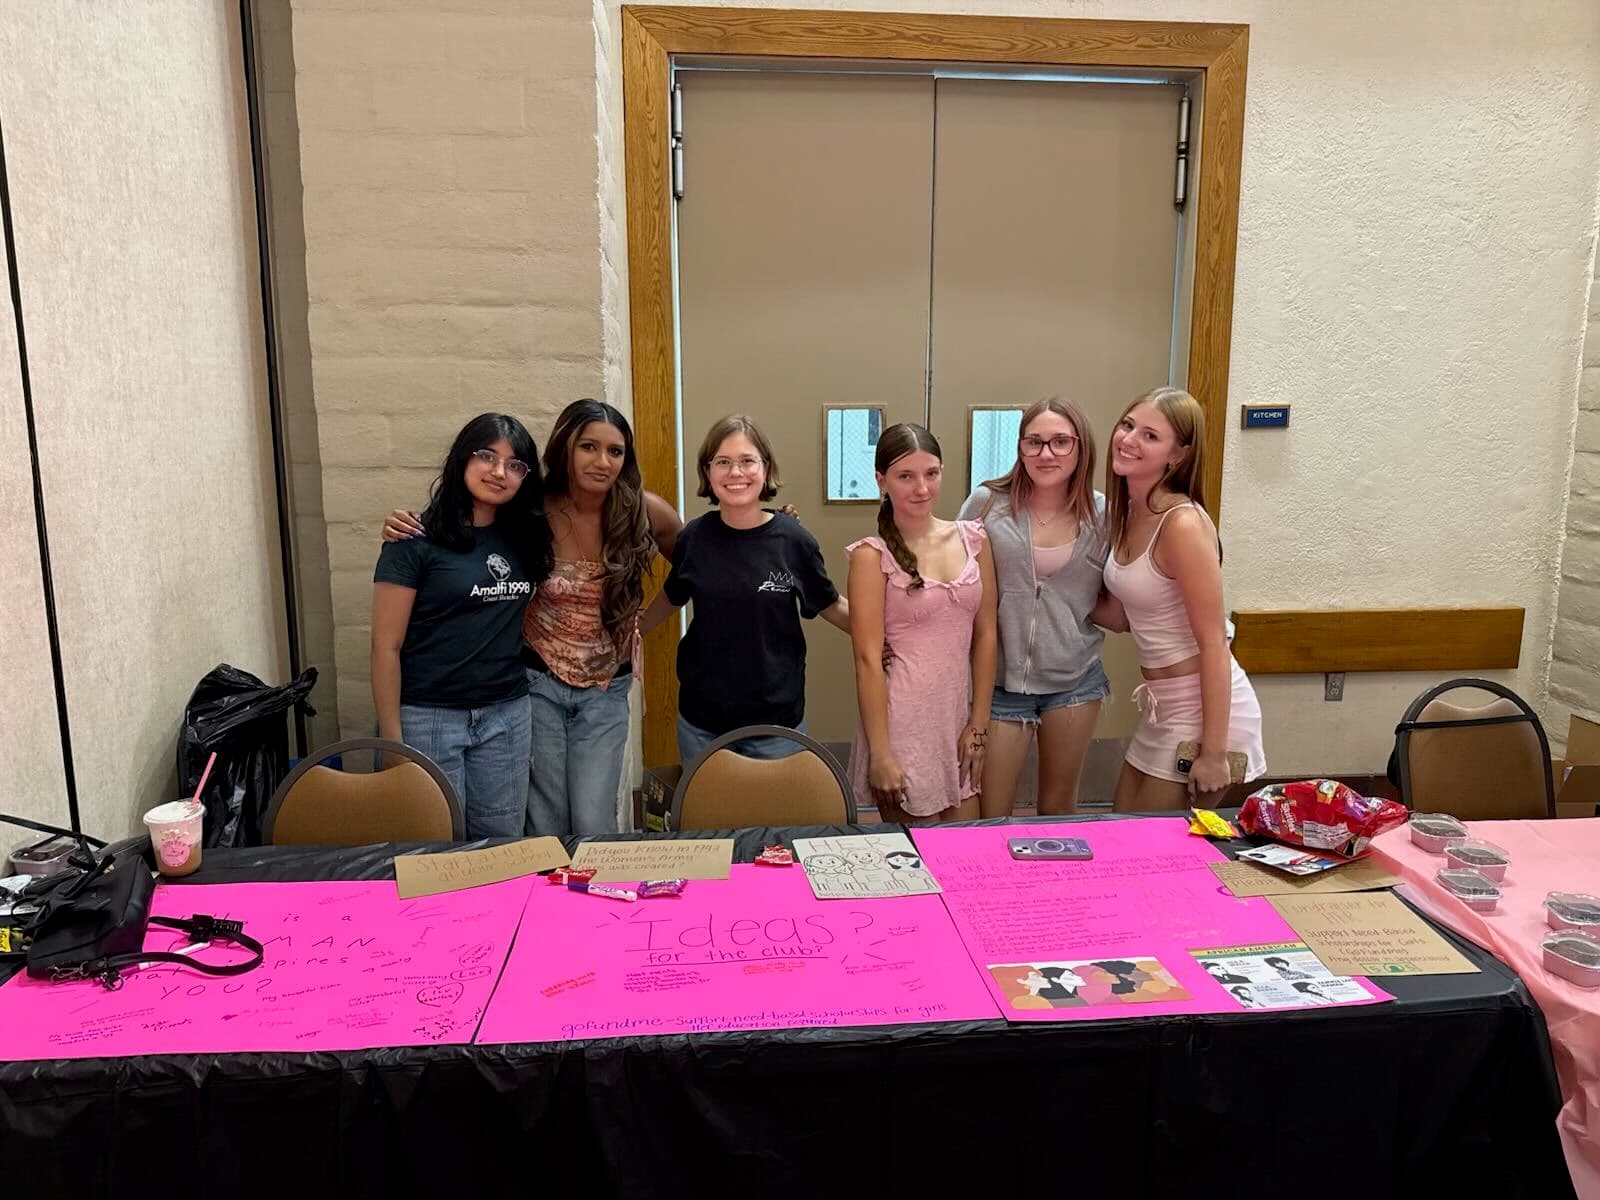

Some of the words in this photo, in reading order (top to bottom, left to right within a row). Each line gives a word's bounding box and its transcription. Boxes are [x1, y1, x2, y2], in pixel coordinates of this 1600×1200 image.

[1253, 411, 1282, 419] KITCHEN
[470, 582, 507, 597] Amalfi
[508, 581, 530, 594] 1998
[283, 913, 300, 923] is
[624, 913, 833, 951] Ideas
[1248, 943, 1297, 952] AMERICAN
